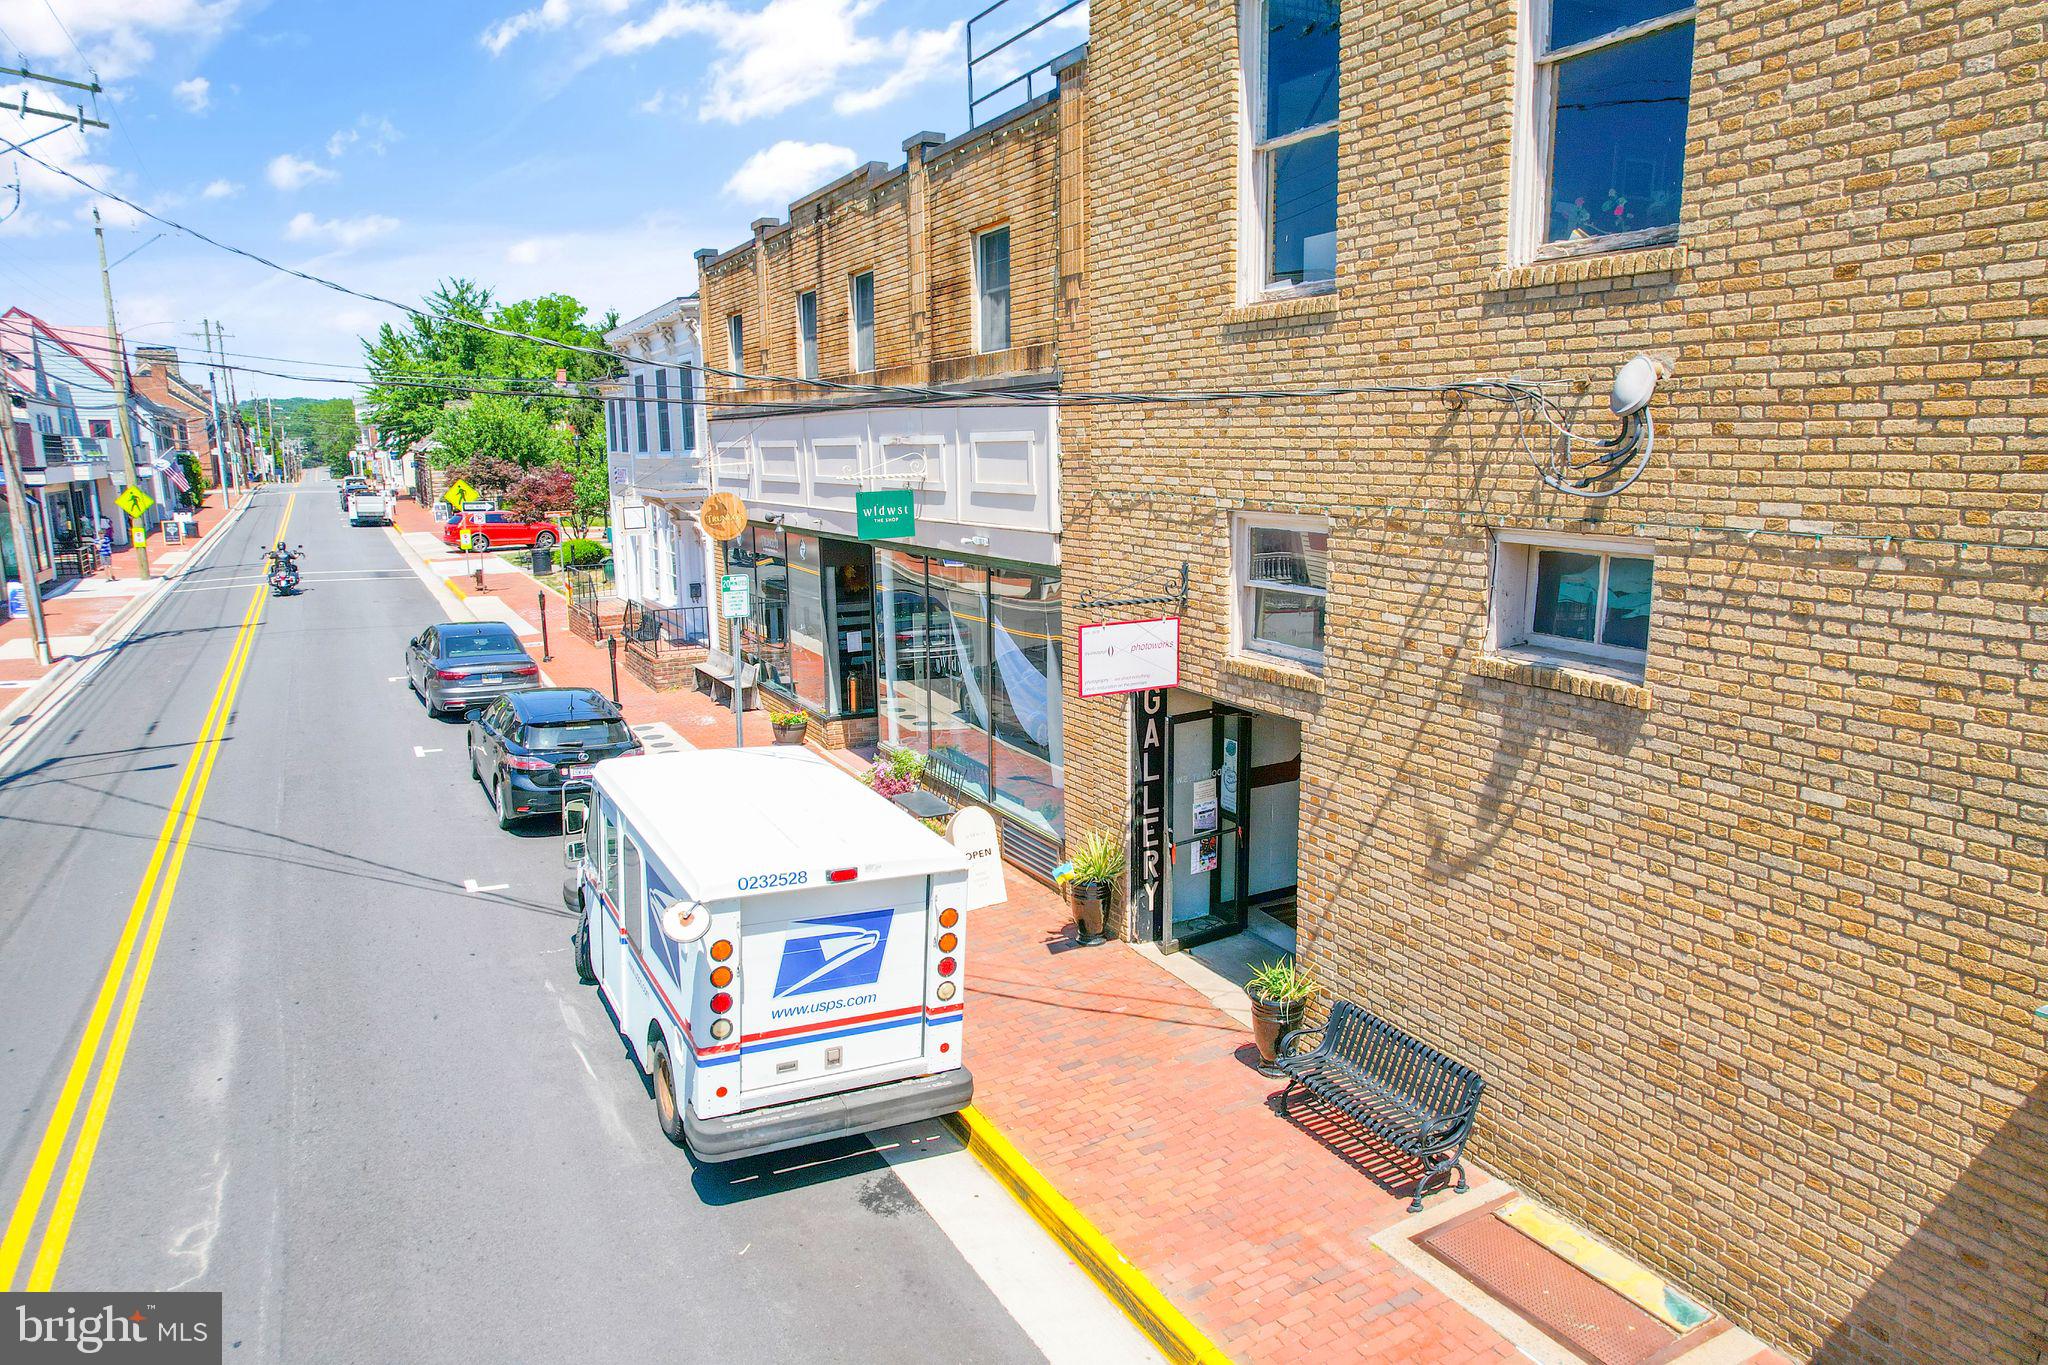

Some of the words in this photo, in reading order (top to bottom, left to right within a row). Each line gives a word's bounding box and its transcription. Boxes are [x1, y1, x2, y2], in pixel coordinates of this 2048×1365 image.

[1130, 640, 1174, 653] photoworks
[1142, 689, 1160, 912] GALLERY
[737, 870, 808, 891] 0232528
[771, 993, 877, 1019] www.usps.com
